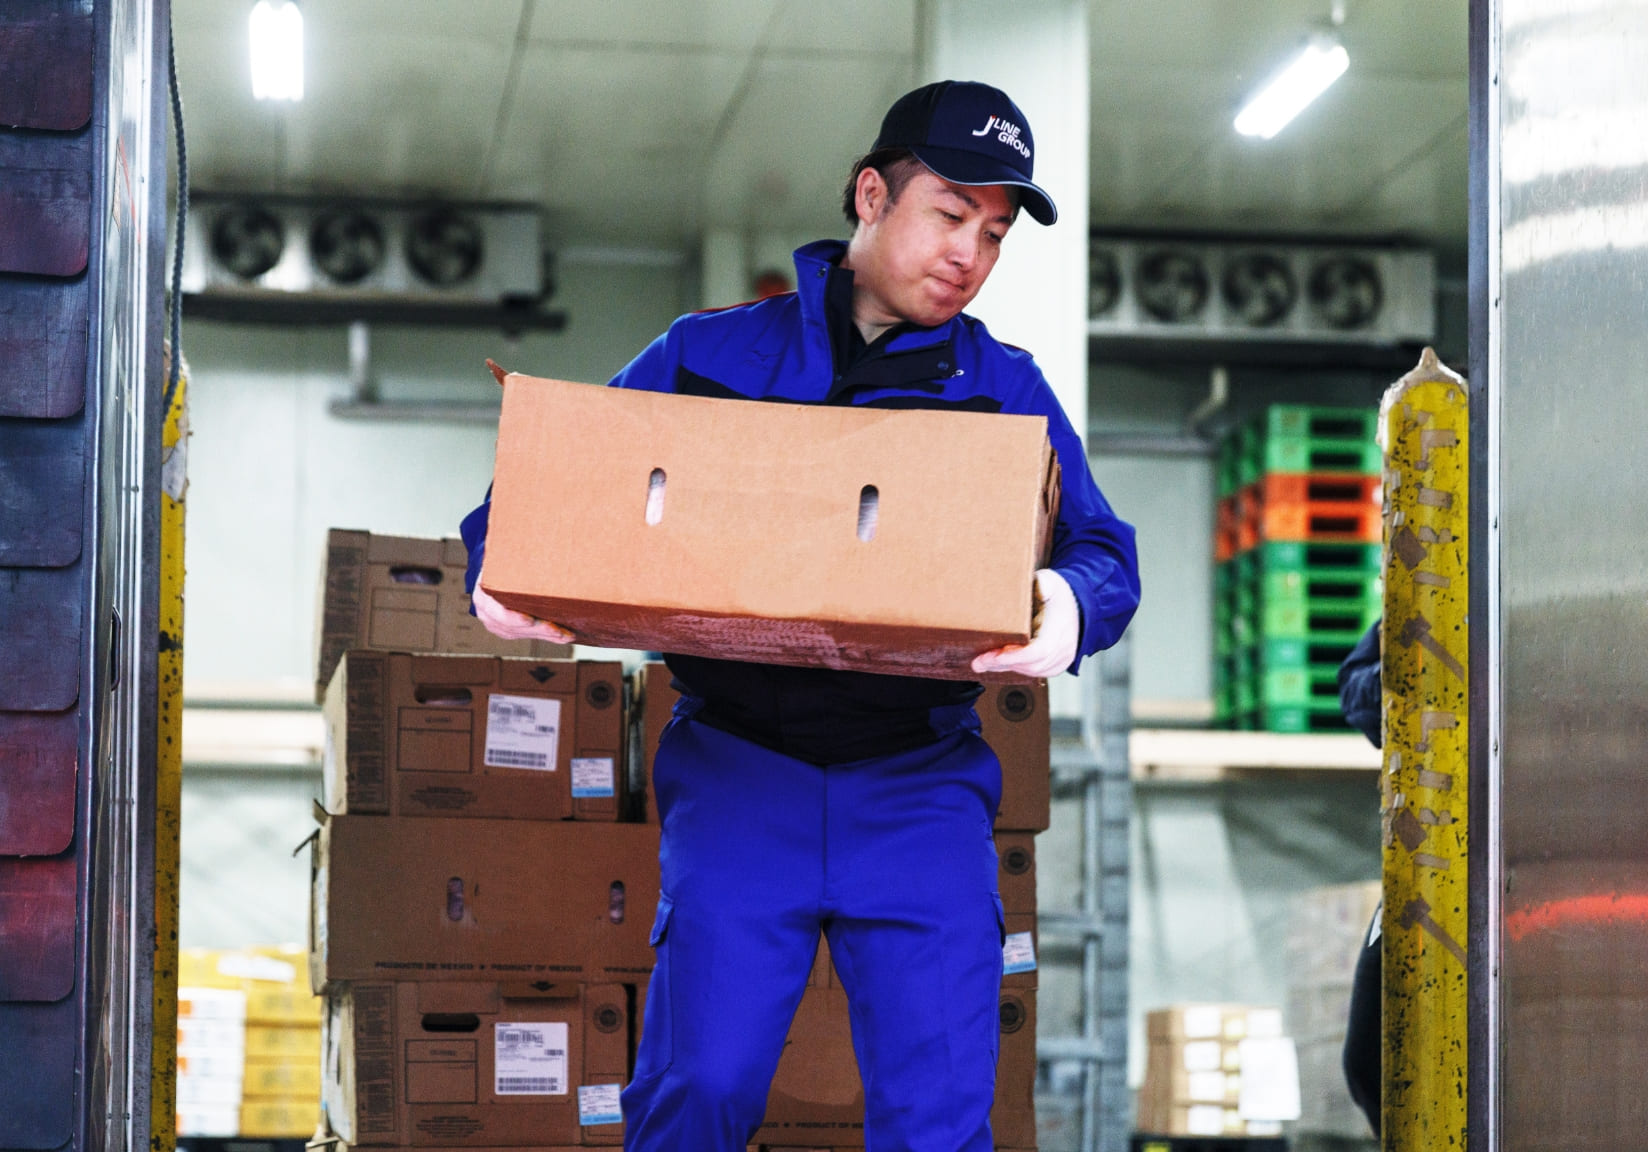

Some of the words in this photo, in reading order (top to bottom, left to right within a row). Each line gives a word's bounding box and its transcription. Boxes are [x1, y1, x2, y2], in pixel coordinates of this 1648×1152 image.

[998, 131, 1031, 159] GROUP
[491, 963, 532, 971] PRODUCT
[548, 964, 583, 972] MEXICO
